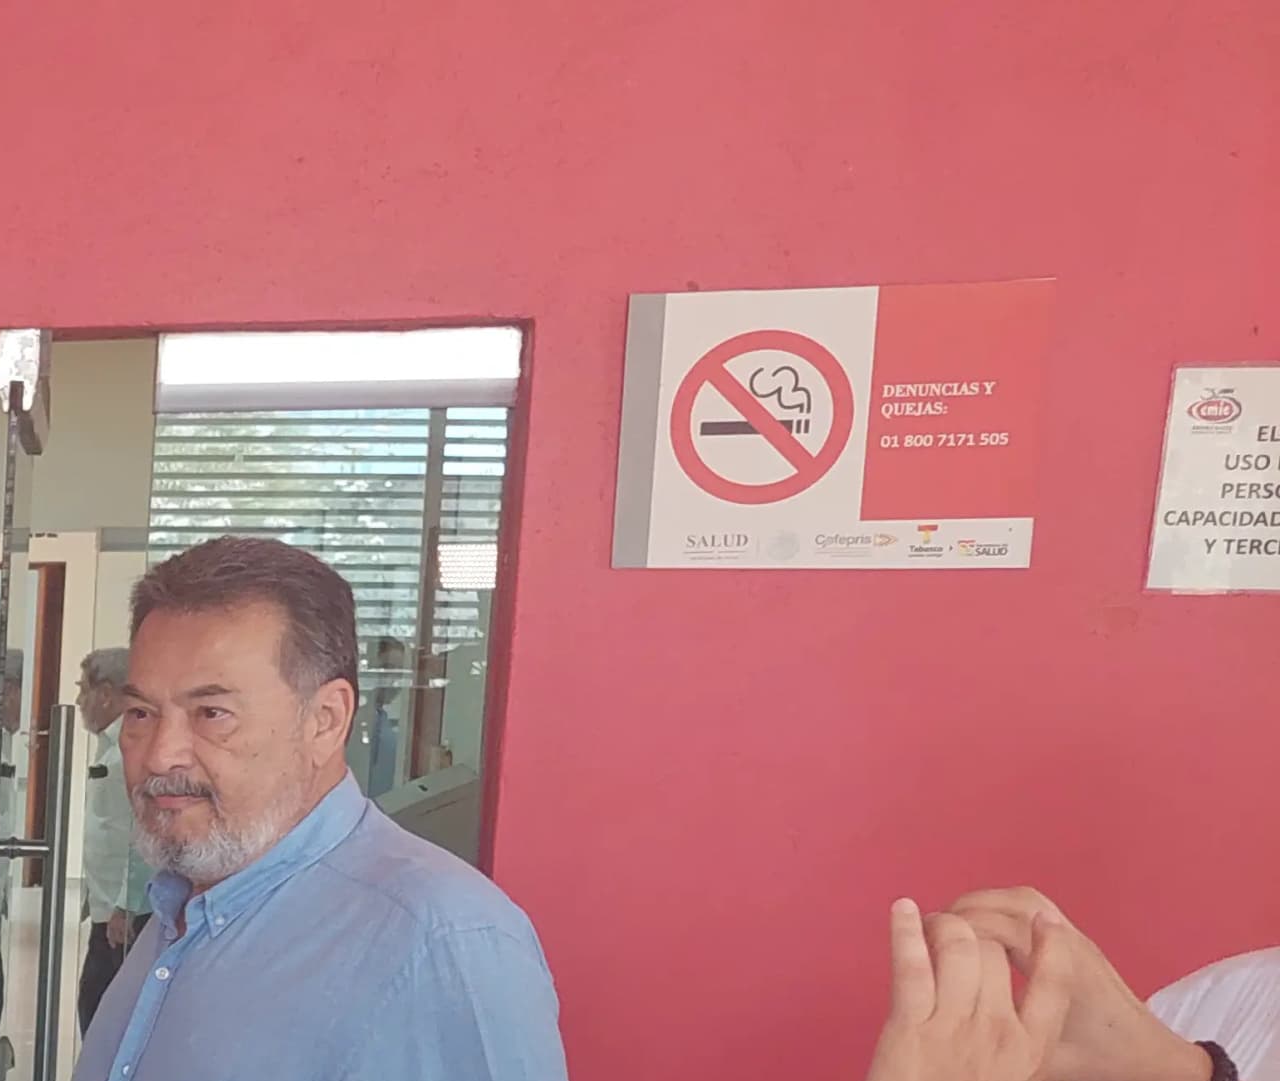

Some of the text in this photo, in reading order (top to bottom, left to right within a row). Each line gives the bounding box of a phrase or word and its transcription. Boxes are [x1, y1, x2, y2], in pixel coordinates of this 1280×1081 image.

[882, 381, 996, 398] DENUNCIAS Y
[881, 401, 949, 419] QUEJAS:
[880, 432, 1009, 448] 01 800 7171 505
[1224, 453, 1271, 471] USO
[1163, 510, 1280, 528] CAPACIDAD
[686, 534, 749, 549] SALUD
[1204, 538, 1280, 556] Y TERC
